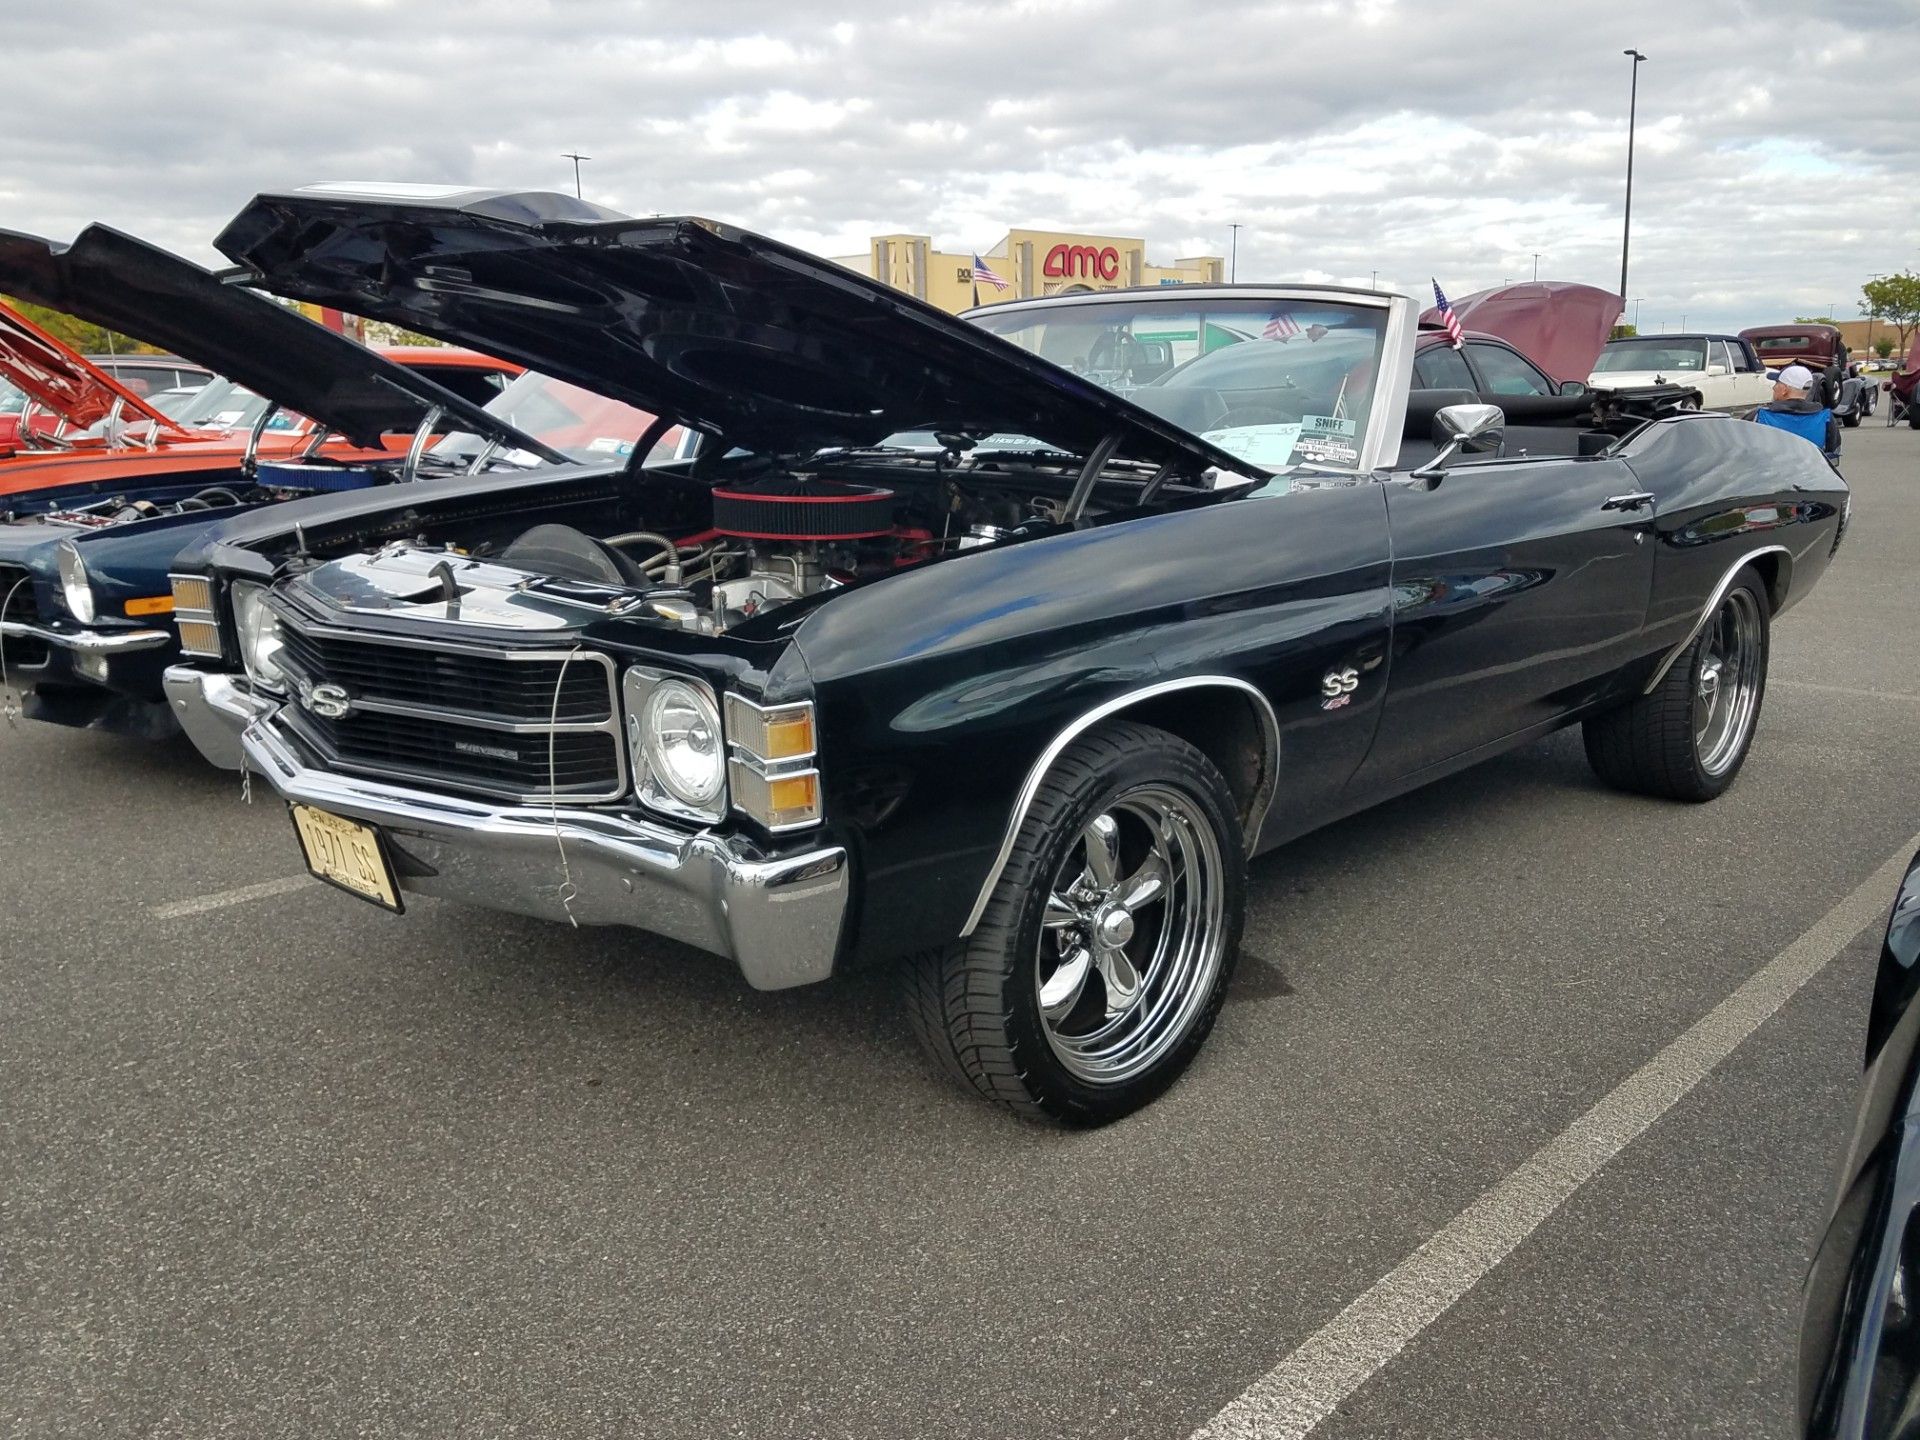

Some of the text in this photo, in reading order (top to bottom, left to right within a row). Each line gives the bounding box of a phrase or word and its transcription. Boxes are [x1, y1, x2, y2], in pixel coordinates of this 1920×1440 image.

[1315, 418, 1344, 430] SNIFF
[299, 676, 350, 720] SS
[1322, 667, 1359, 696] SS
[306, 823, 377, 884] 1971 SS
